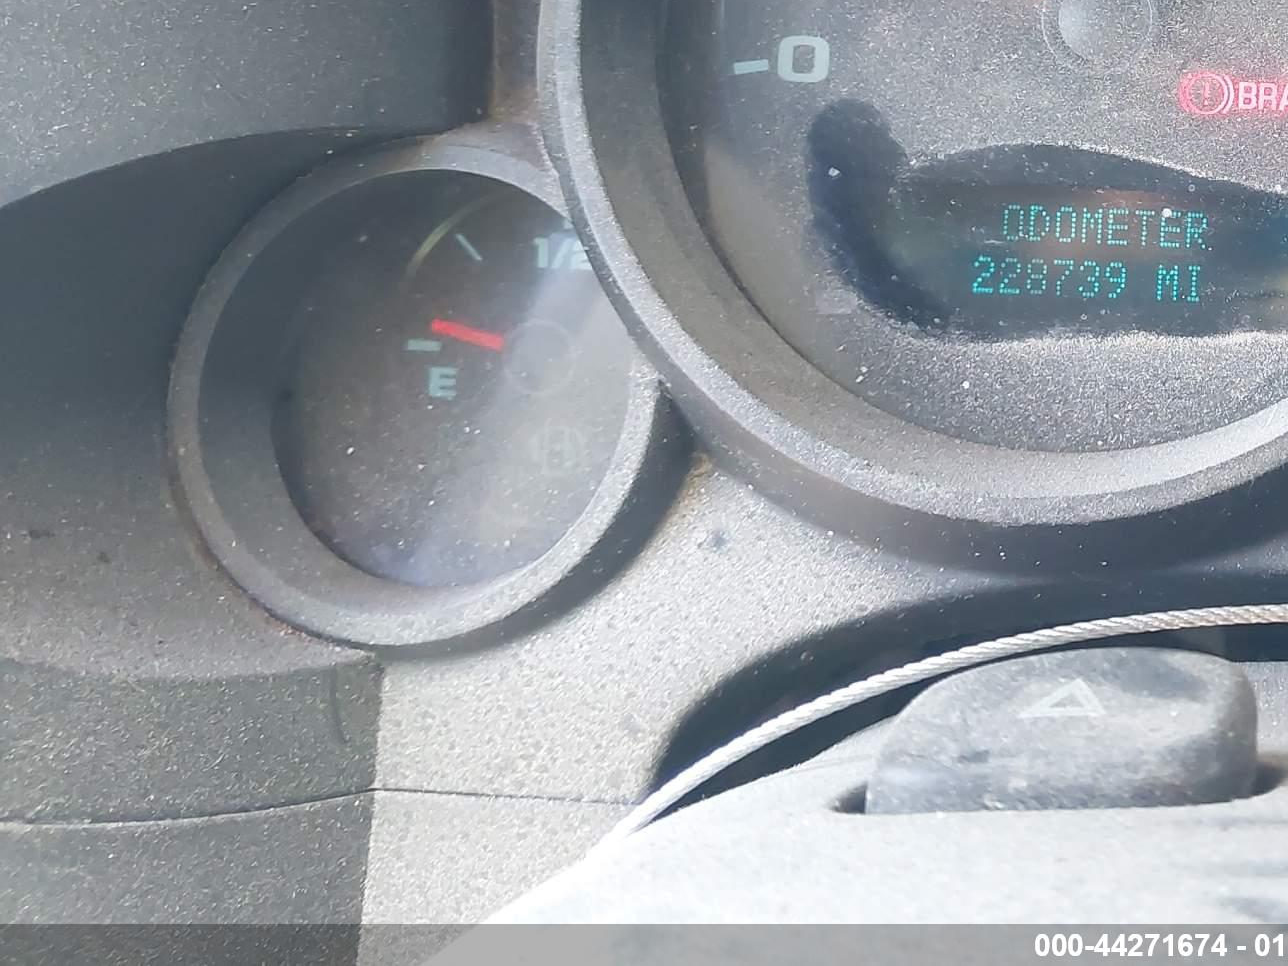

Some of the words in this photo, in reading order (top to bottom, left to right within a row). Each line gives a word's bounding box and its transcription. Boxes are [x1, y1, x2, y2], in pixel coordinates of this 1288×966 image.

[778, 36, 829, 84] 0
[1002, 205, 1209, 249] ODOMETER
[972, 255, 1128, 299] 228739
[1157, 265, 1201, 302] MI
[428, 367, 458, 401] E
